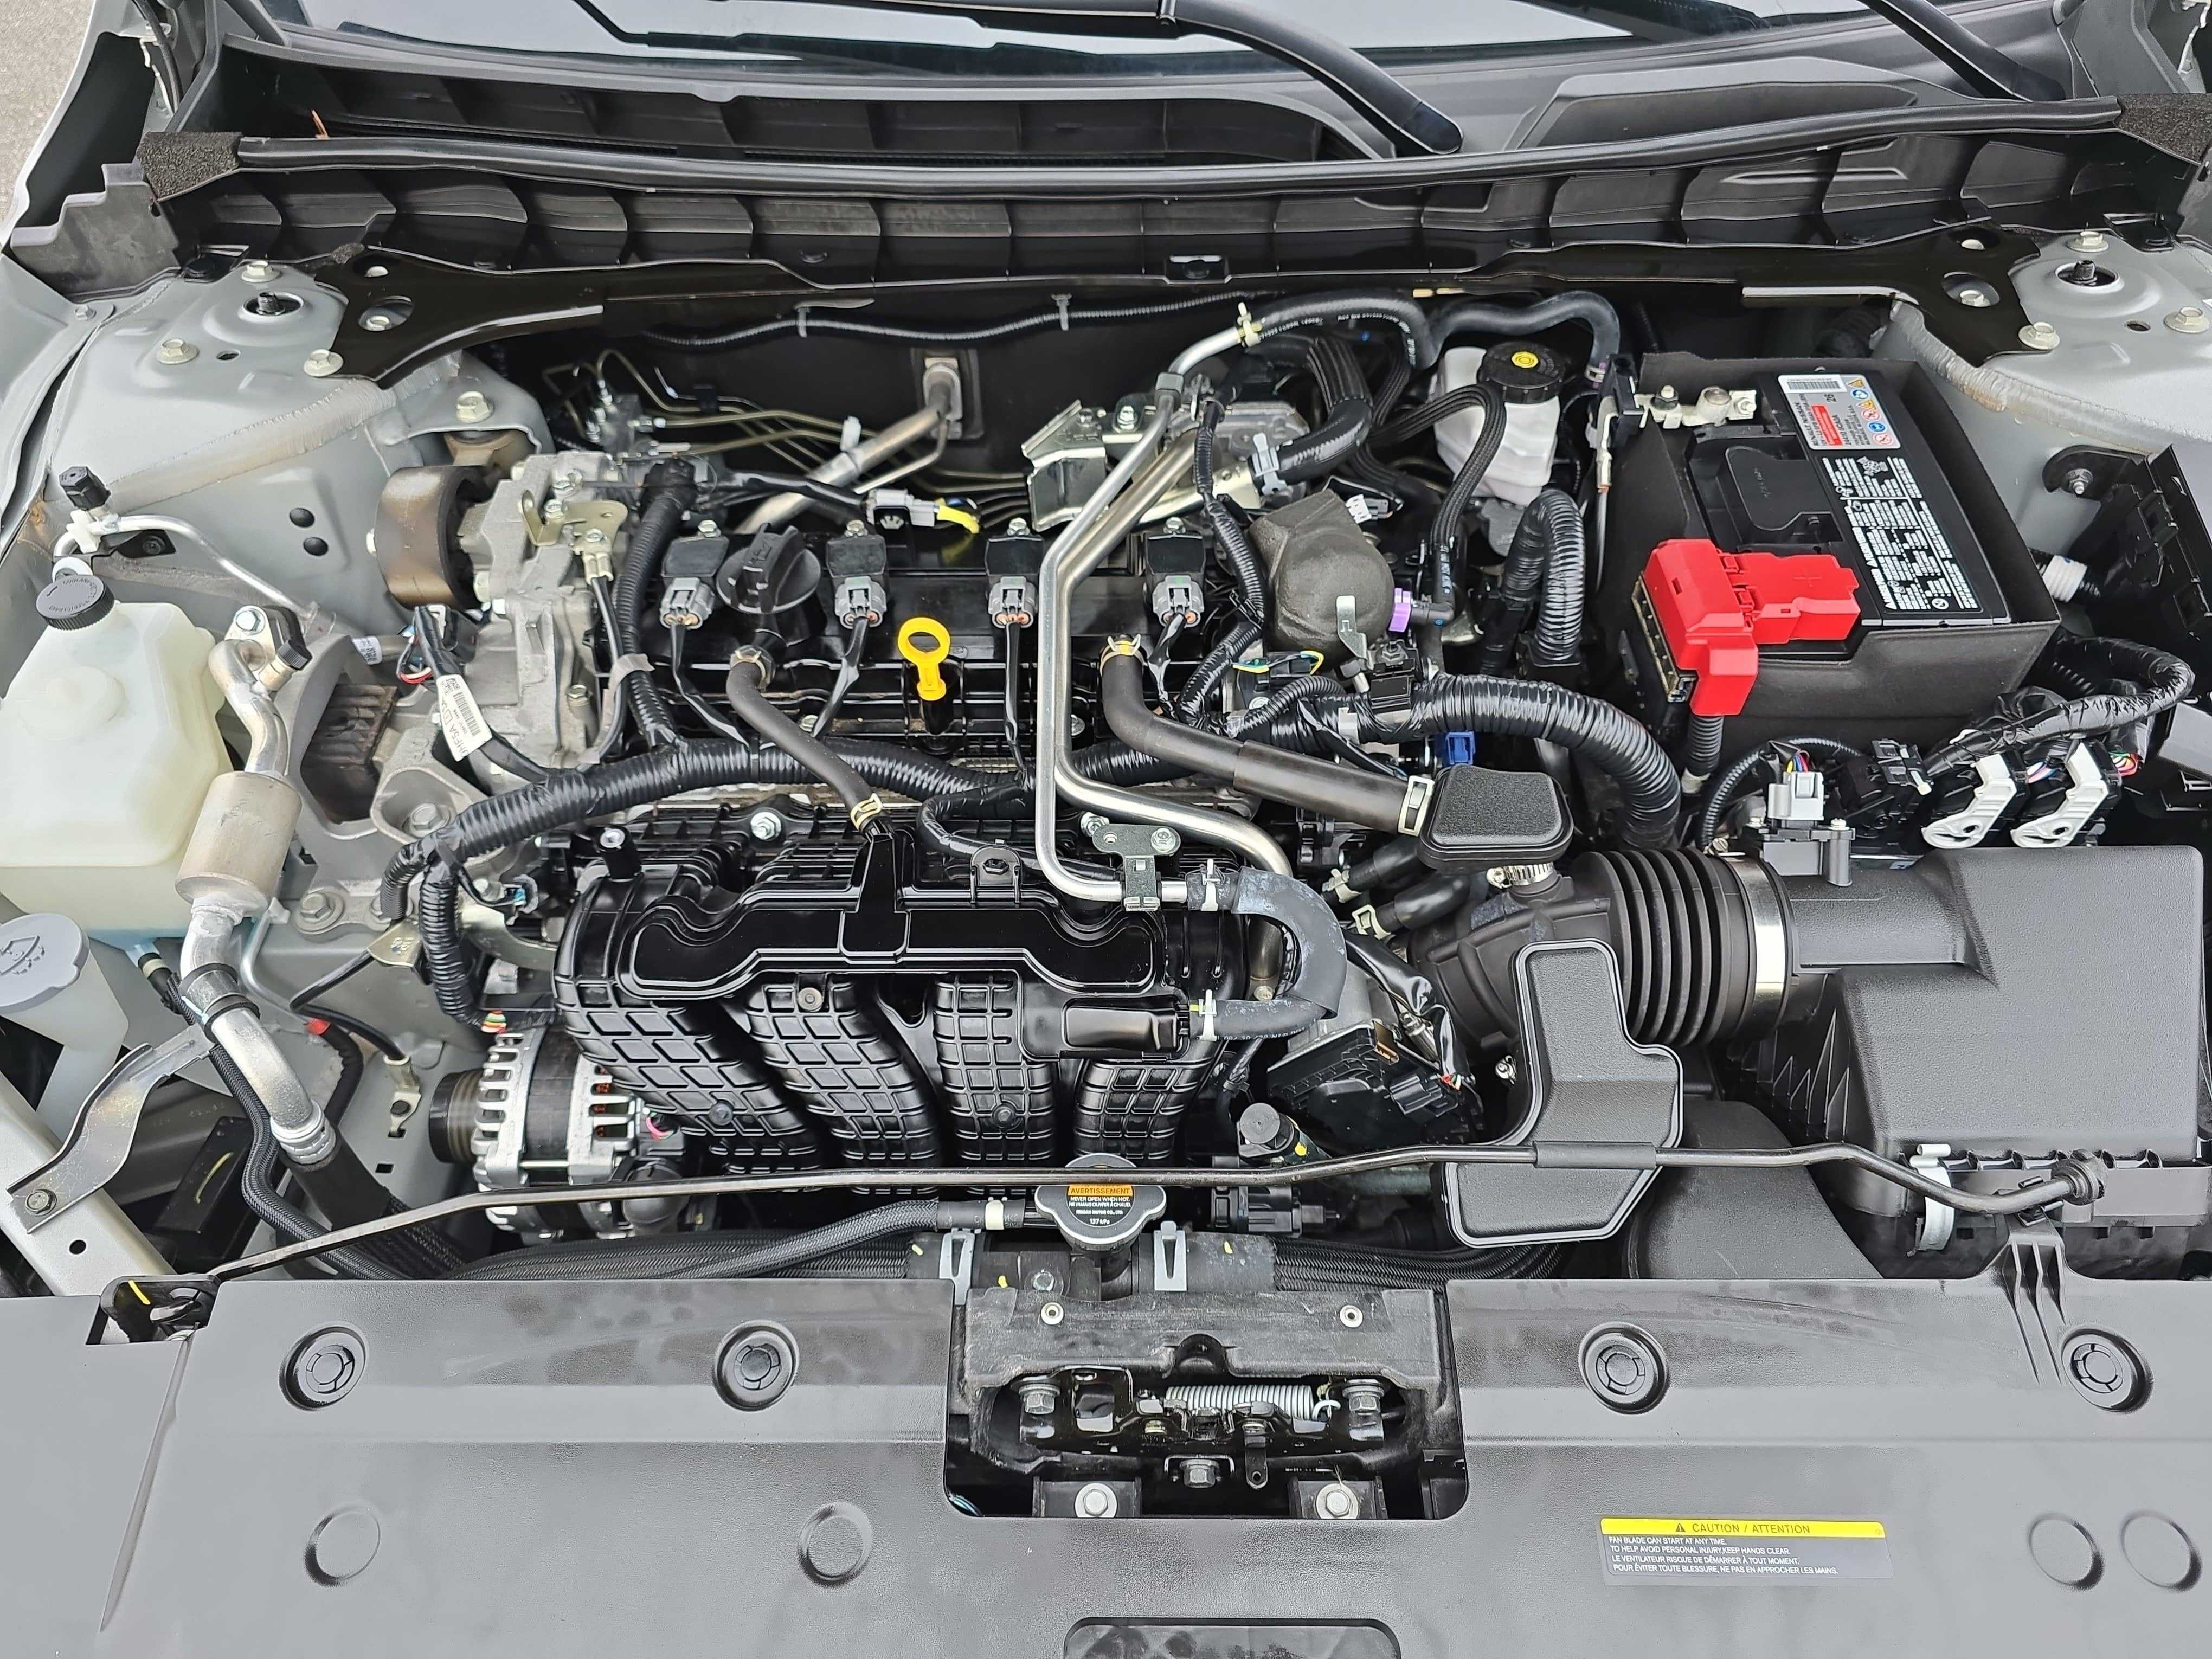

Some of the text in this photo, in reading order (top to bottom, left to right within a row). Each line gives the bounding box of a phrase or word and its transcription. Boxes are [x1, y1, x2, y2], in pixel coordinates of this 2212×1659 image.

[1824, 394, 1836, 402] 26
[1794, 402, 1809, 423] NISSAN
[1692, 1523, 1740, 1533] CAUTION
[1751, 1525, 1810, 1533] ATTENTION
[1703, 1555, 1742, 1564] DÉMARRER
[1742, 1555, 1747, 1564] À
[1634, 1563, 1658, 1572] ÉVITER
[1681, 1565, 1720, 1574] BLESSURE,
